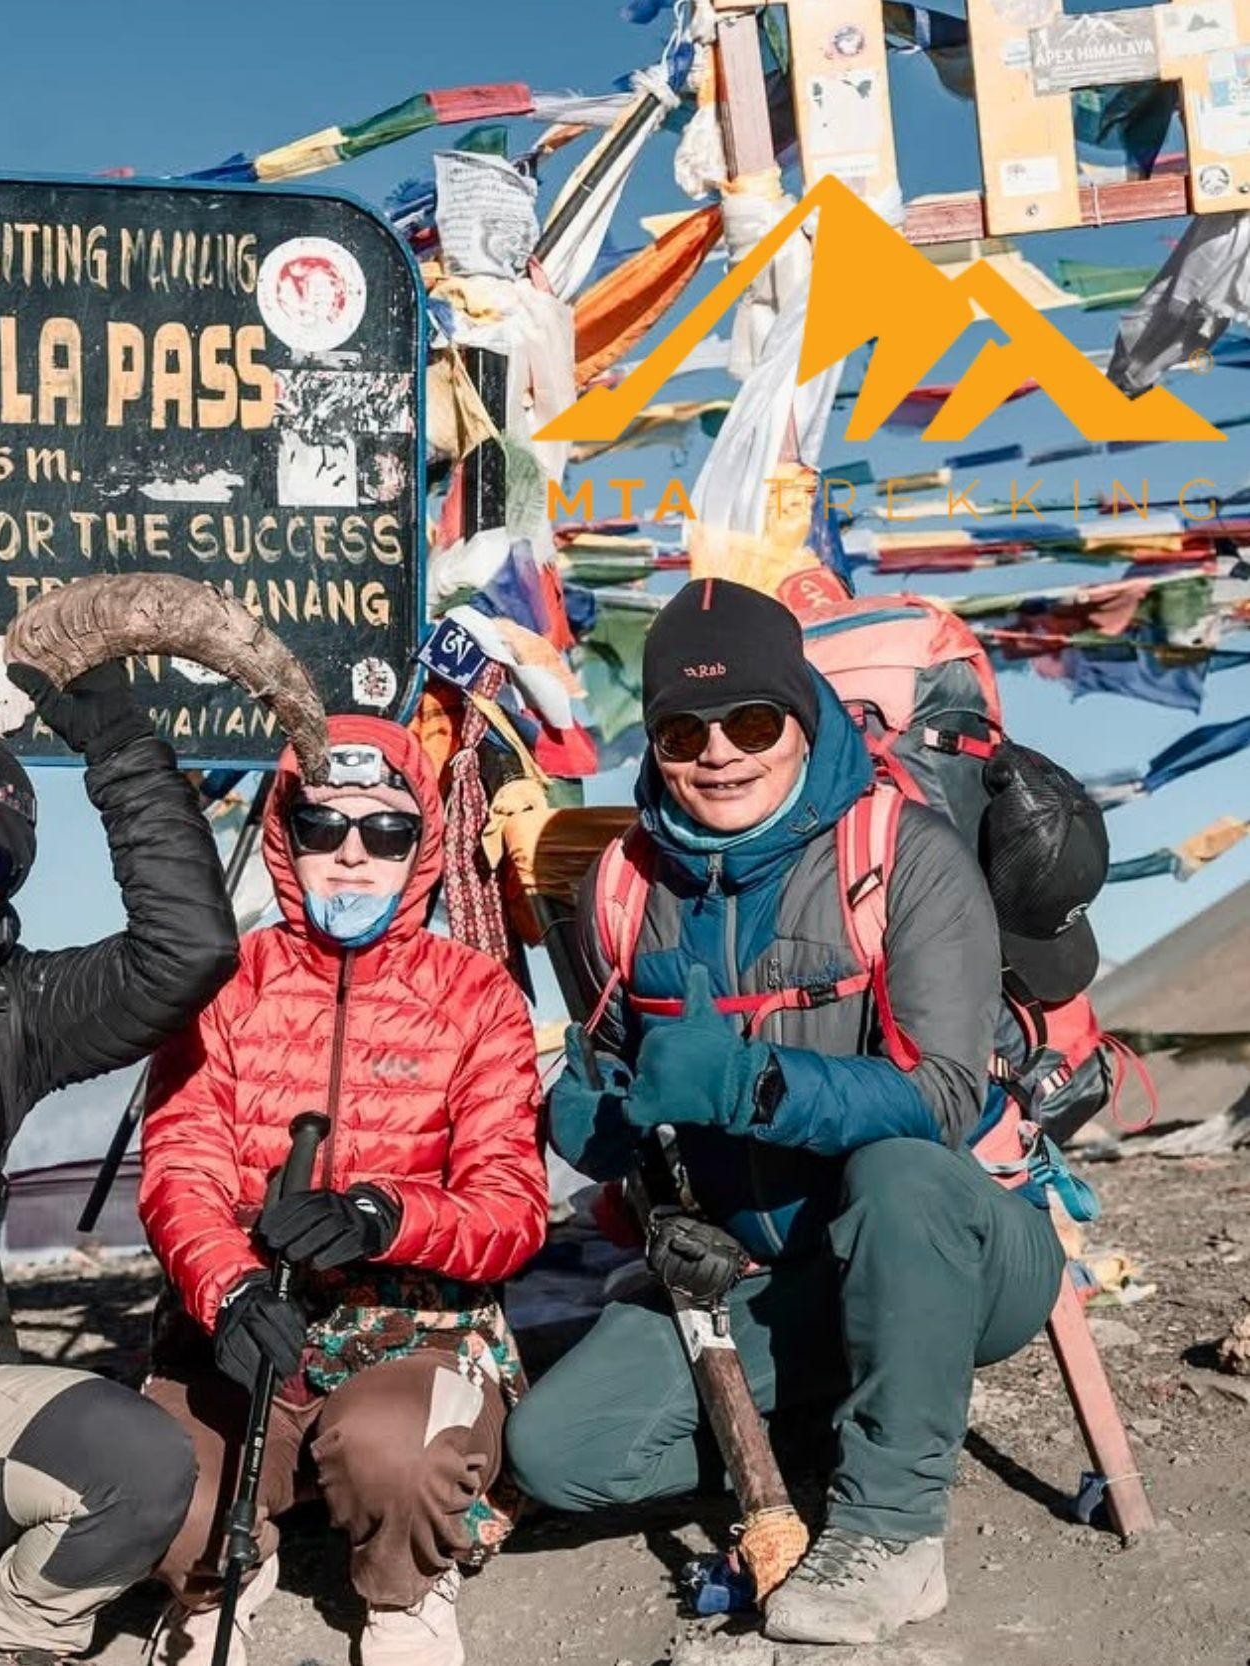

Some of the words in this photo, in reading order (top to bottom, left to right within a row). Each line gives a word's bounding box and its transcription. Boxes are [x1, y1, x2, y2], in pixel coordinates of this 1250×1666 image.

[106, 321, 277, 431] PASS
[70, 512, 171, 560] THE
[187, 514, 403, 565] SUCCESS
[699, 661, 727, 678] Rab
